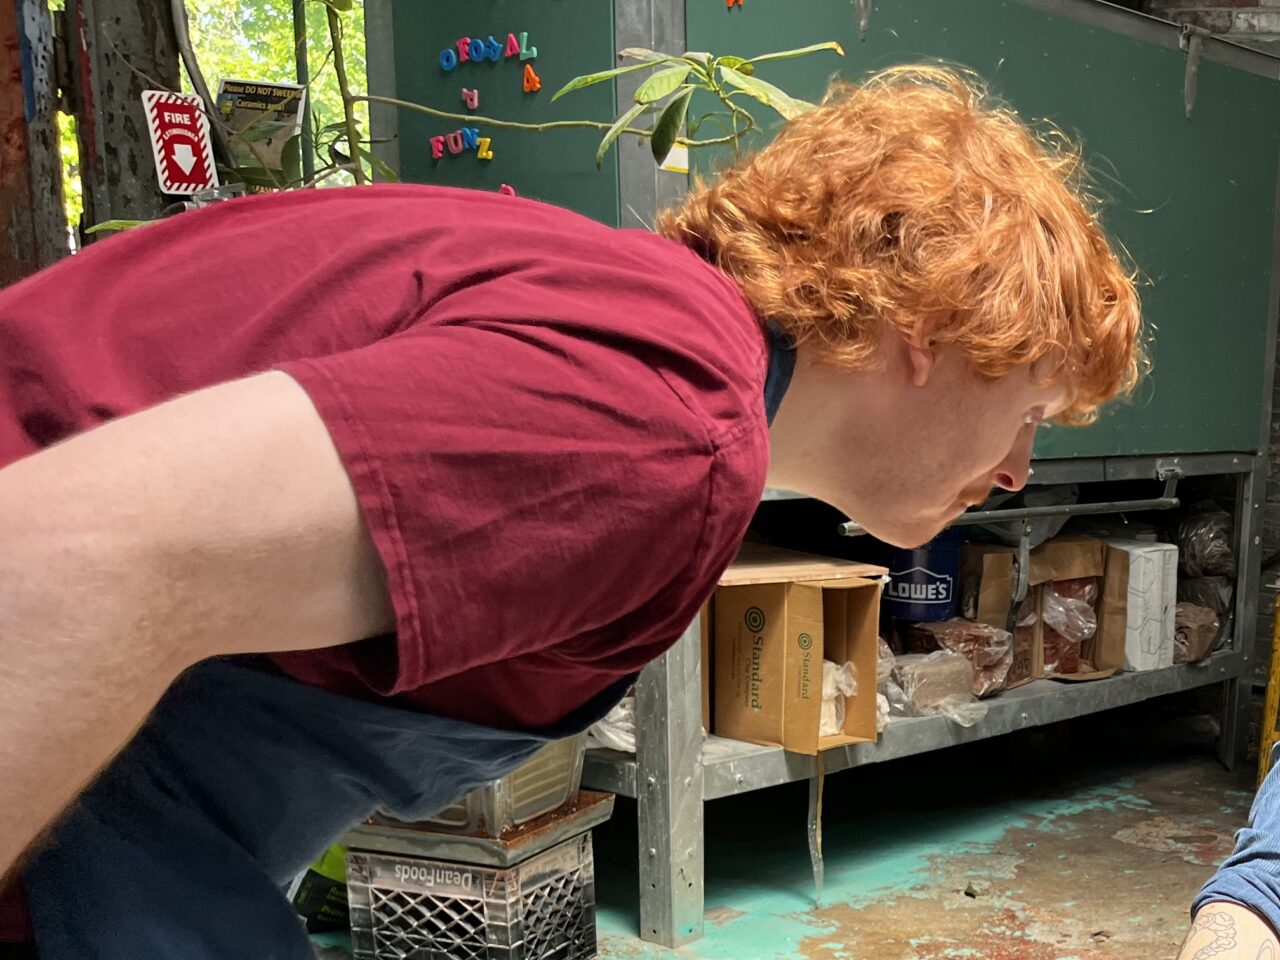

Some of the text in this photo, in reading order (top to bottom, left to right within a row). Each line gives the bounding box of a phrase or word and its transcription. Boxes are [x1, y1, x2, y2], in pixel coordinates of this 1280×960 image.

[245, 86, 256, 94] DO
[257, 87, 272, 96] NOT
[237, 99, 266, 109] Ceramics
[164, 112, 191, 125] FIRE
[889, 581, 947, 599] LOWE'S
[752, 635, 764, 710] Standard
[802, 651, 811, 700] Standard
[395, 864, 472, 891] DeanFoods
